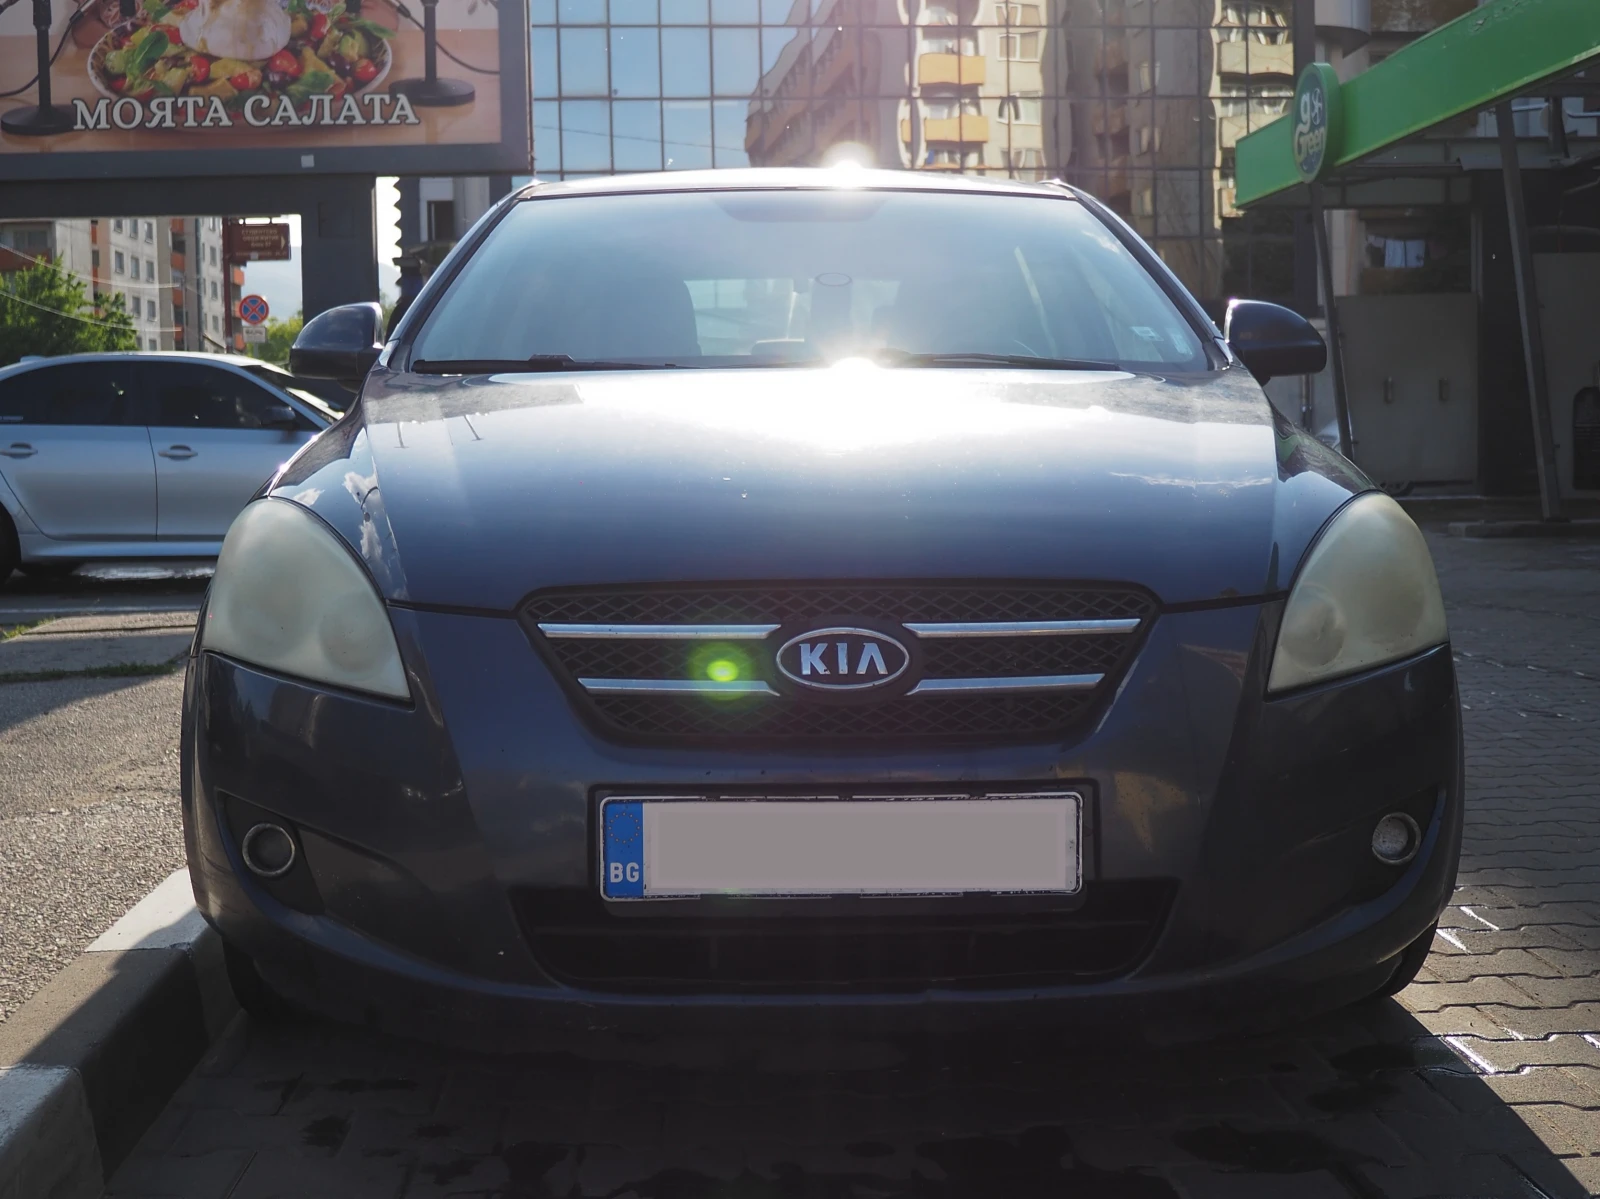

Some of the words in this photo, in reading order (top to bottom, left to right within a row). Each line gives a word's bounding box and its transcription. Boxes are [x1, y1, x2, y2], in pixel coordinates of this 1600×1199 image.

[73, 97, 233, 130] МОЯТА
[244, 93, 420, 127] САЛАТА
[799, 642, 888, 675] KIA
[610, 862, 639, 883] BG
